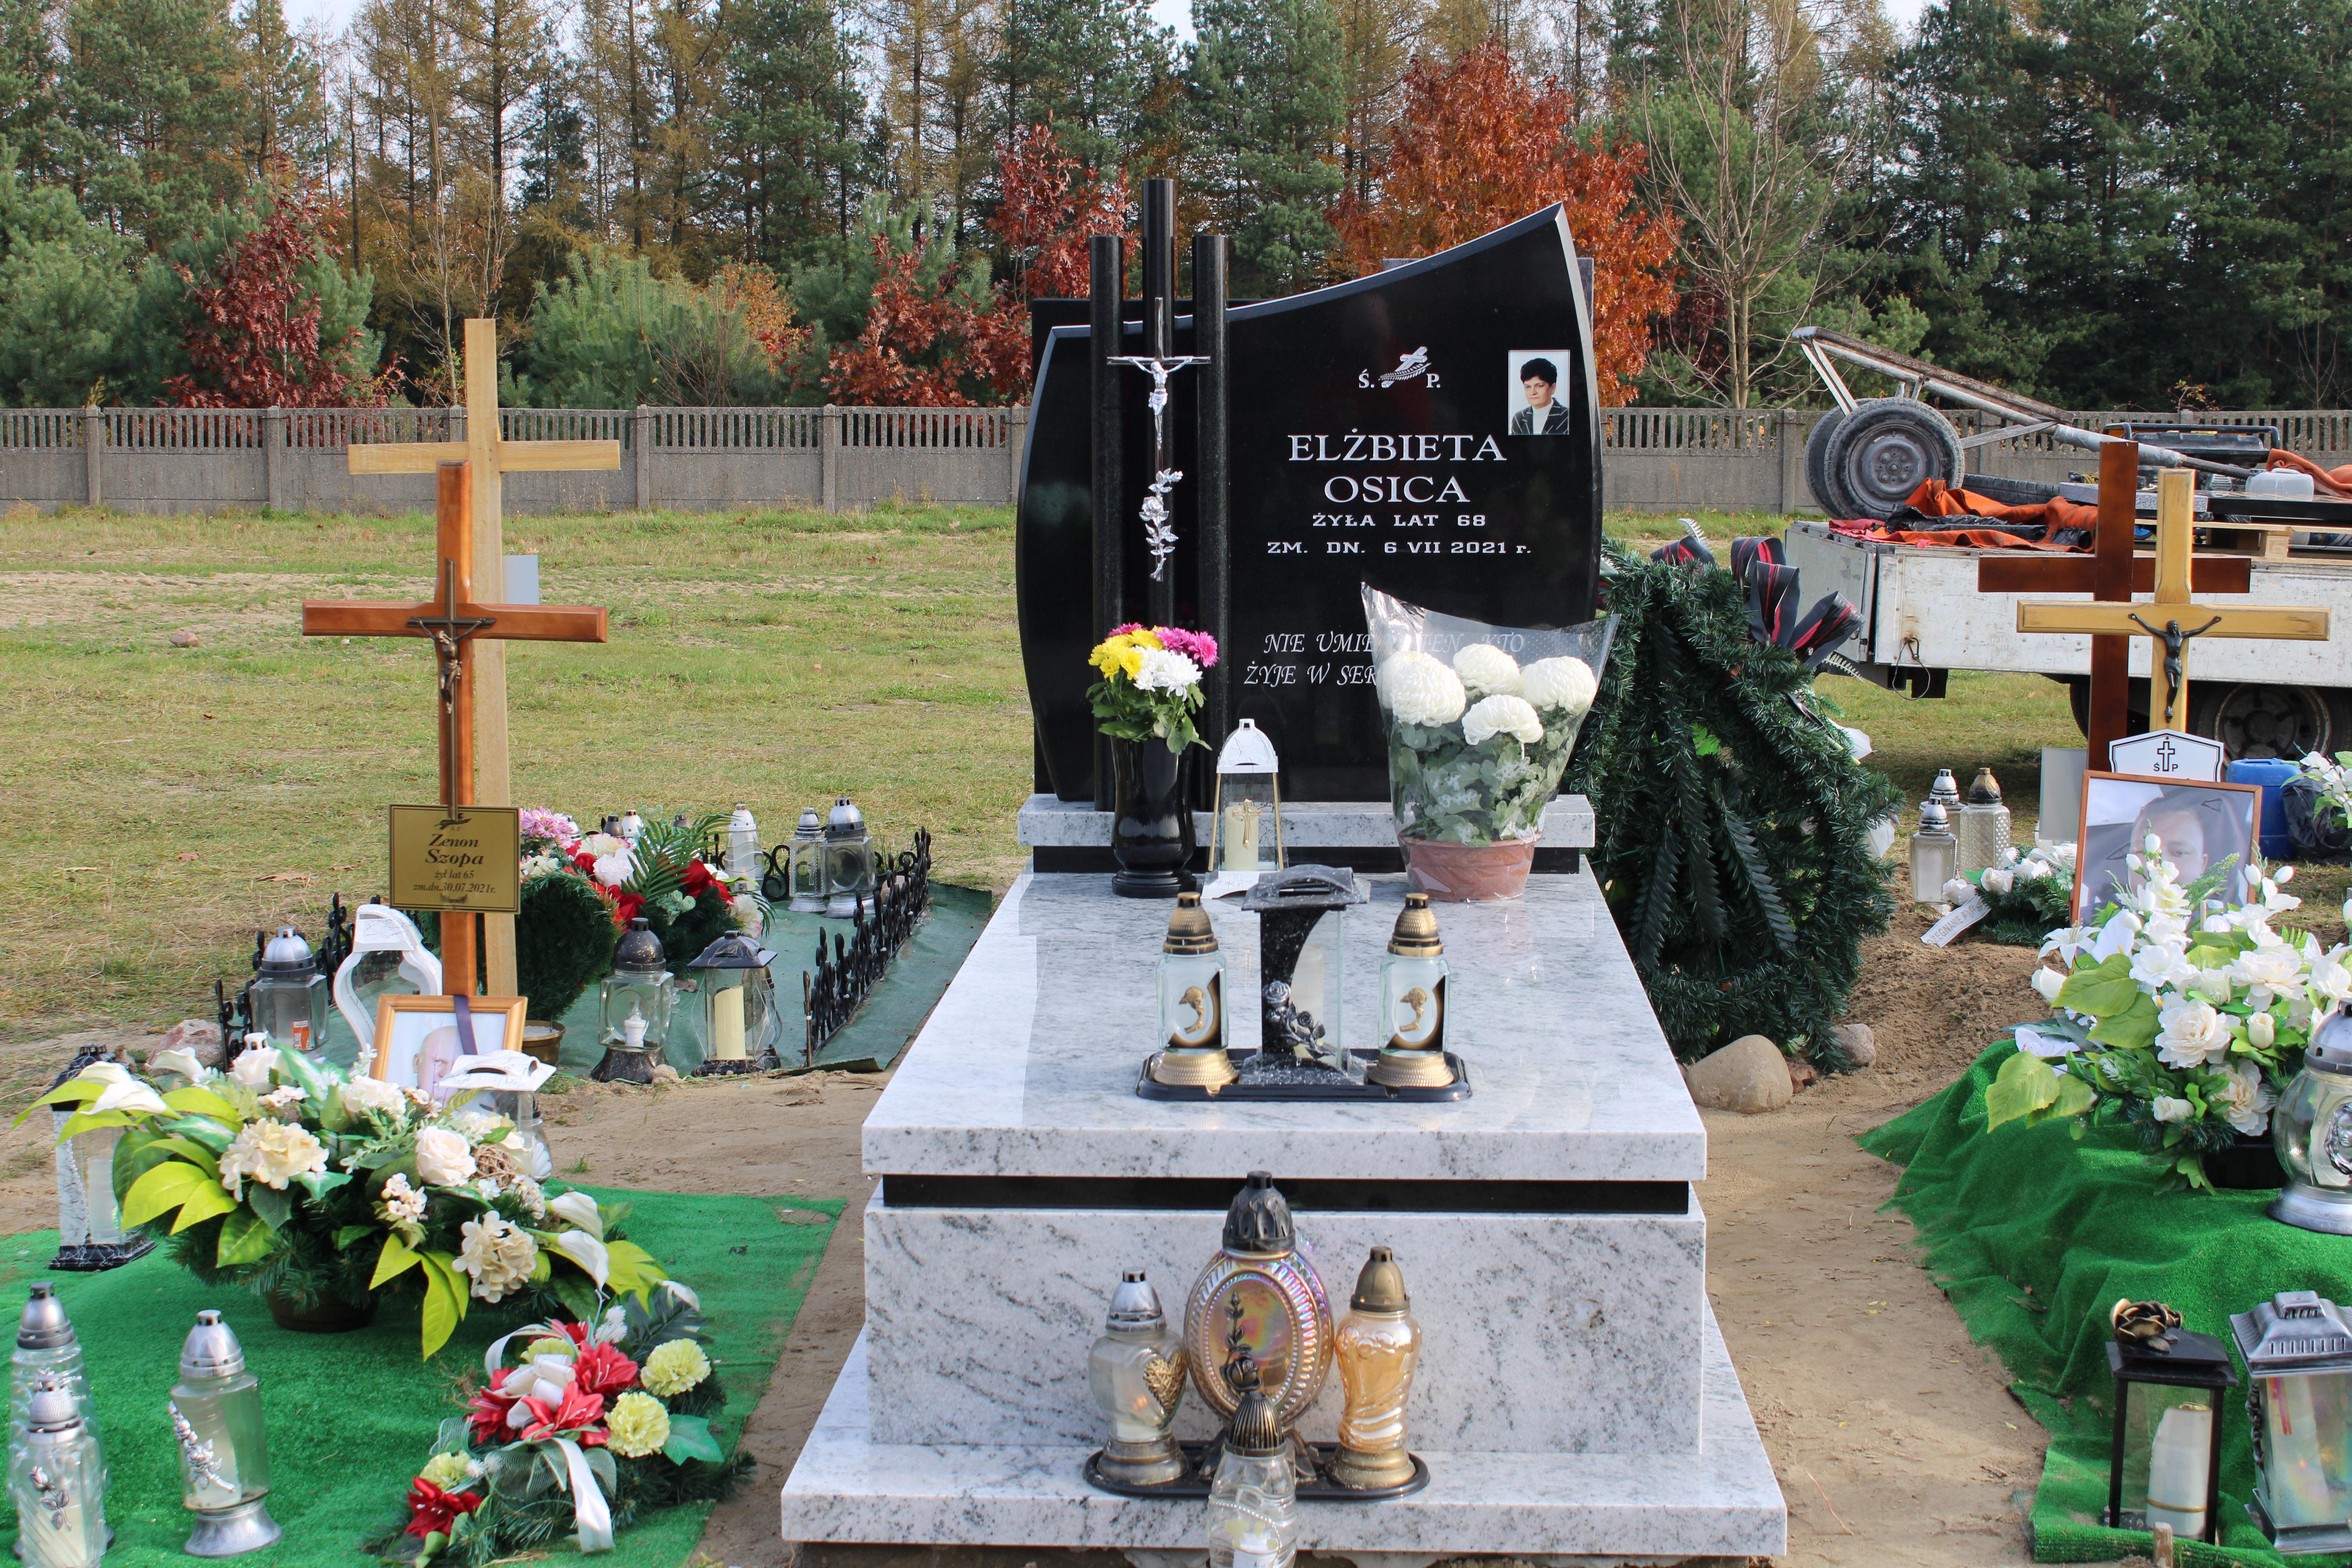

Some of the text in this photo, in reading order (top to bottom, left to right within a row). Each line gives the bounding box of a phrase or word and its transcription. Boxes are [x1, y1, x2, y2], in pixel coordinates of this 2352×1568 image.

[1359, 368, 1441, 388] Ś. P.
[1287, 428, 1507, 461] ELŻBIETA
[1324, 476, 1470, 503] OSICA
[1312, 512, 1486, 526] ŻYŁA LAT 68
[1267, 542, 1531, 554] ZM. DN. 6 VII 2021 r.
[1263, 633, 1305, 653] NIE
[1316, 630, 1373, 653] UMIE
[1243, 661, 1376, 688] ŻYJE W SER
[2172, 764, 2178, 772] P
[428, 833, 479, 848] Zenon
[425, 849, 484, 867] Szopa
[434, 869, 474, 880] żył lat 65
[1926, 915, 1964, 945] OŻEGNANIE
